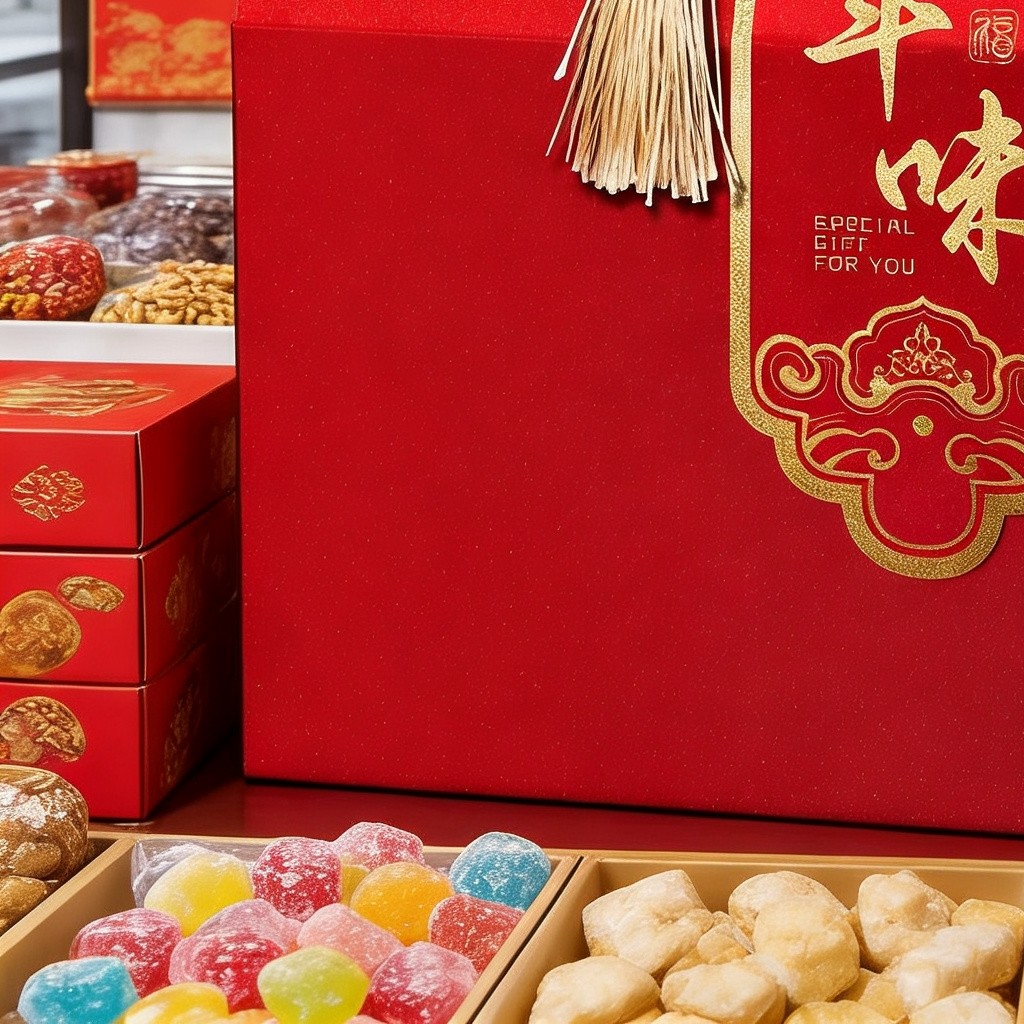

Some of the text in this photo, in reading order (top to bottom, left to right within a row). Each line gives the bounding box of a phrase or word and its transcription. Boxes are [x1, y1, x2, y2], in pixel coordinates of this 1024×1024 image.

[974, 15, 1014, 59] 福
[814, 255, 914, 275] FOR YOU
